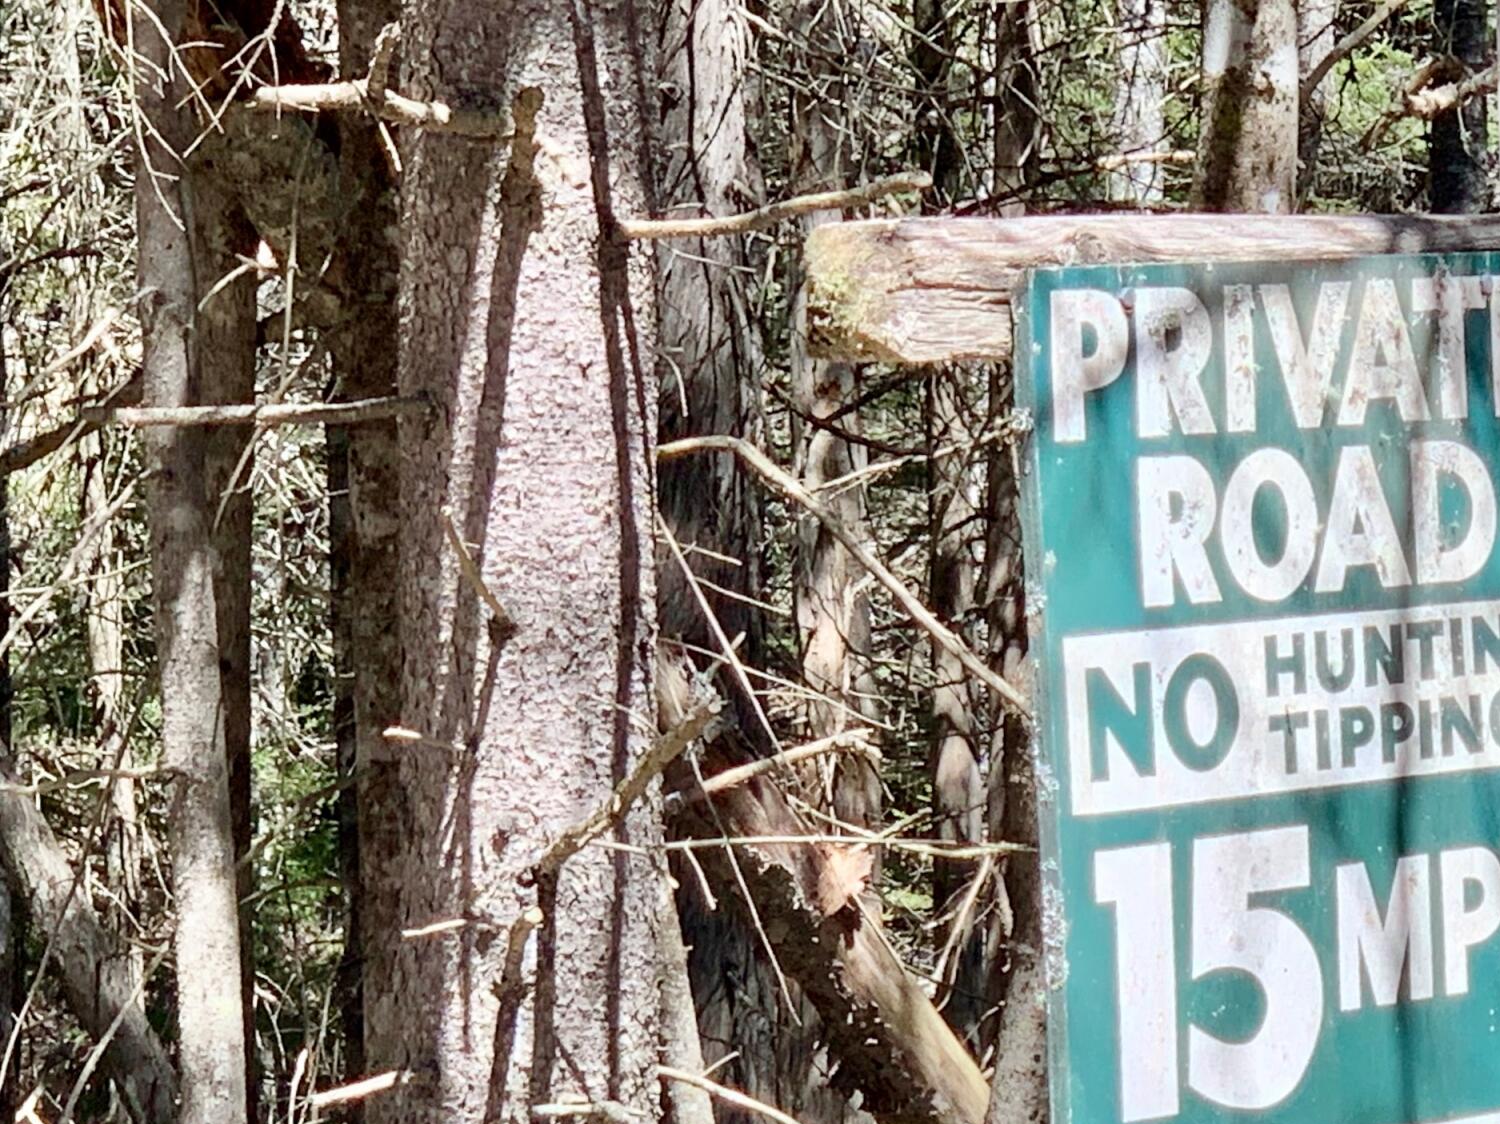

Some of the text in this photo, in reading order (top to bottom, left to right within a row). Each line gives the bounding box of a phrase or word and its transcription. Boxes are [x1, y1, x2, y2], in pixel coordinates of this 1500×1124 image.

[1137, 440, 1497, 608] ROAD
[1084, 653, 1240, 782] NO
[1094, 824, 1323, 1123] 15
